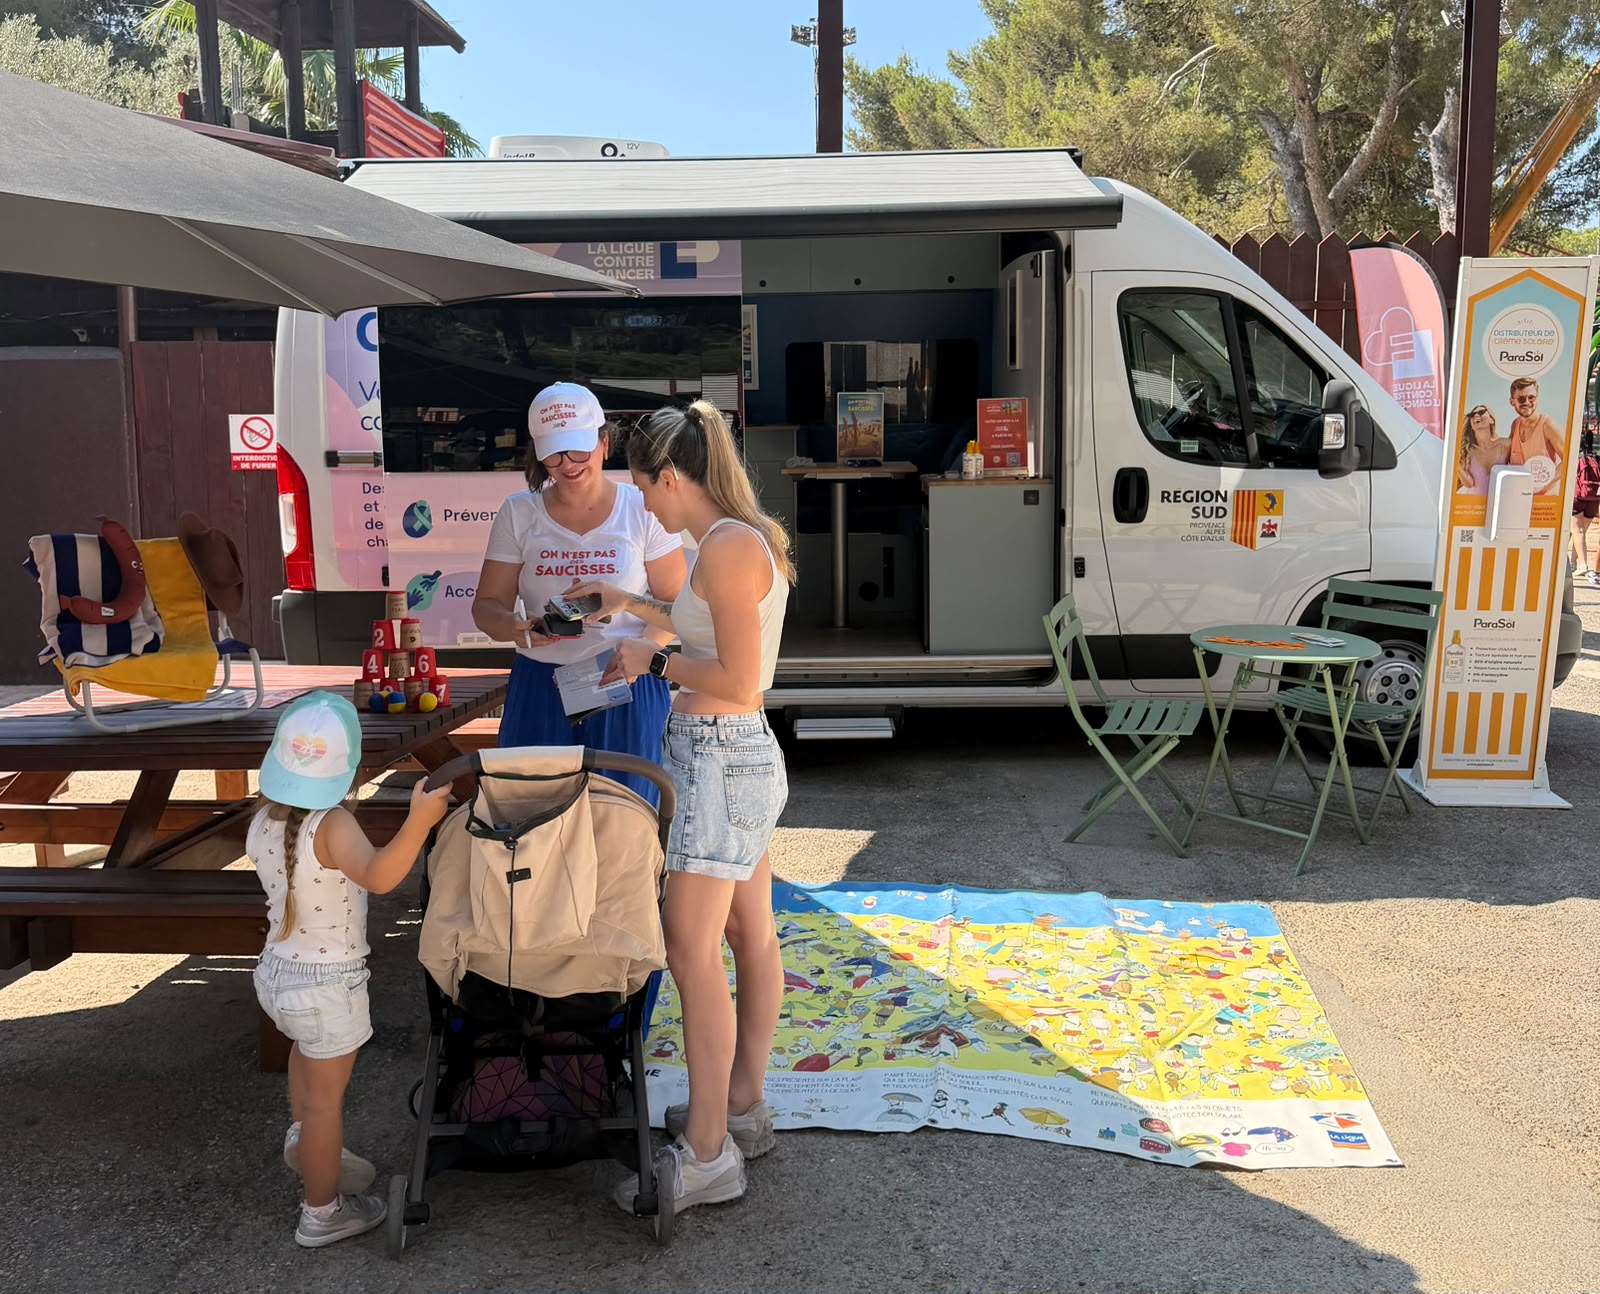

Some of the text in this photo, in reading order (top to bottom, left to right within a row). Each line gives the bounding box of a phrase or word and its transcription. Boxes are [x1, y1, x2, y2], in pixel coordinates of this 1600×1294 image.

[587, 242, 654, 254] LA LIGUE
[593, 255, 654, 267] CONTRE
[1499, 351, 1544, 362] ParaSol
[359, 380, 380, 401] V
[540, 407, 548, 415] ON
[549, 403, 563, 412] N'EST
[363, 501, 379, 513] et
[1191, 506, 1228, 519] SUD
[540, 550, 616, 559] ON N'EST PAS
[535, 564, 619, 576] SAUCISSES.
[444, 585, 478, 598] Acc
[1473, 618, 1515, 629] ParaSol
[374, 628, 385, 648] 2
[367, 654, 379, 673] 4
[419, 654, 429, 673] 6
[436, 684, 447, 702] 7
